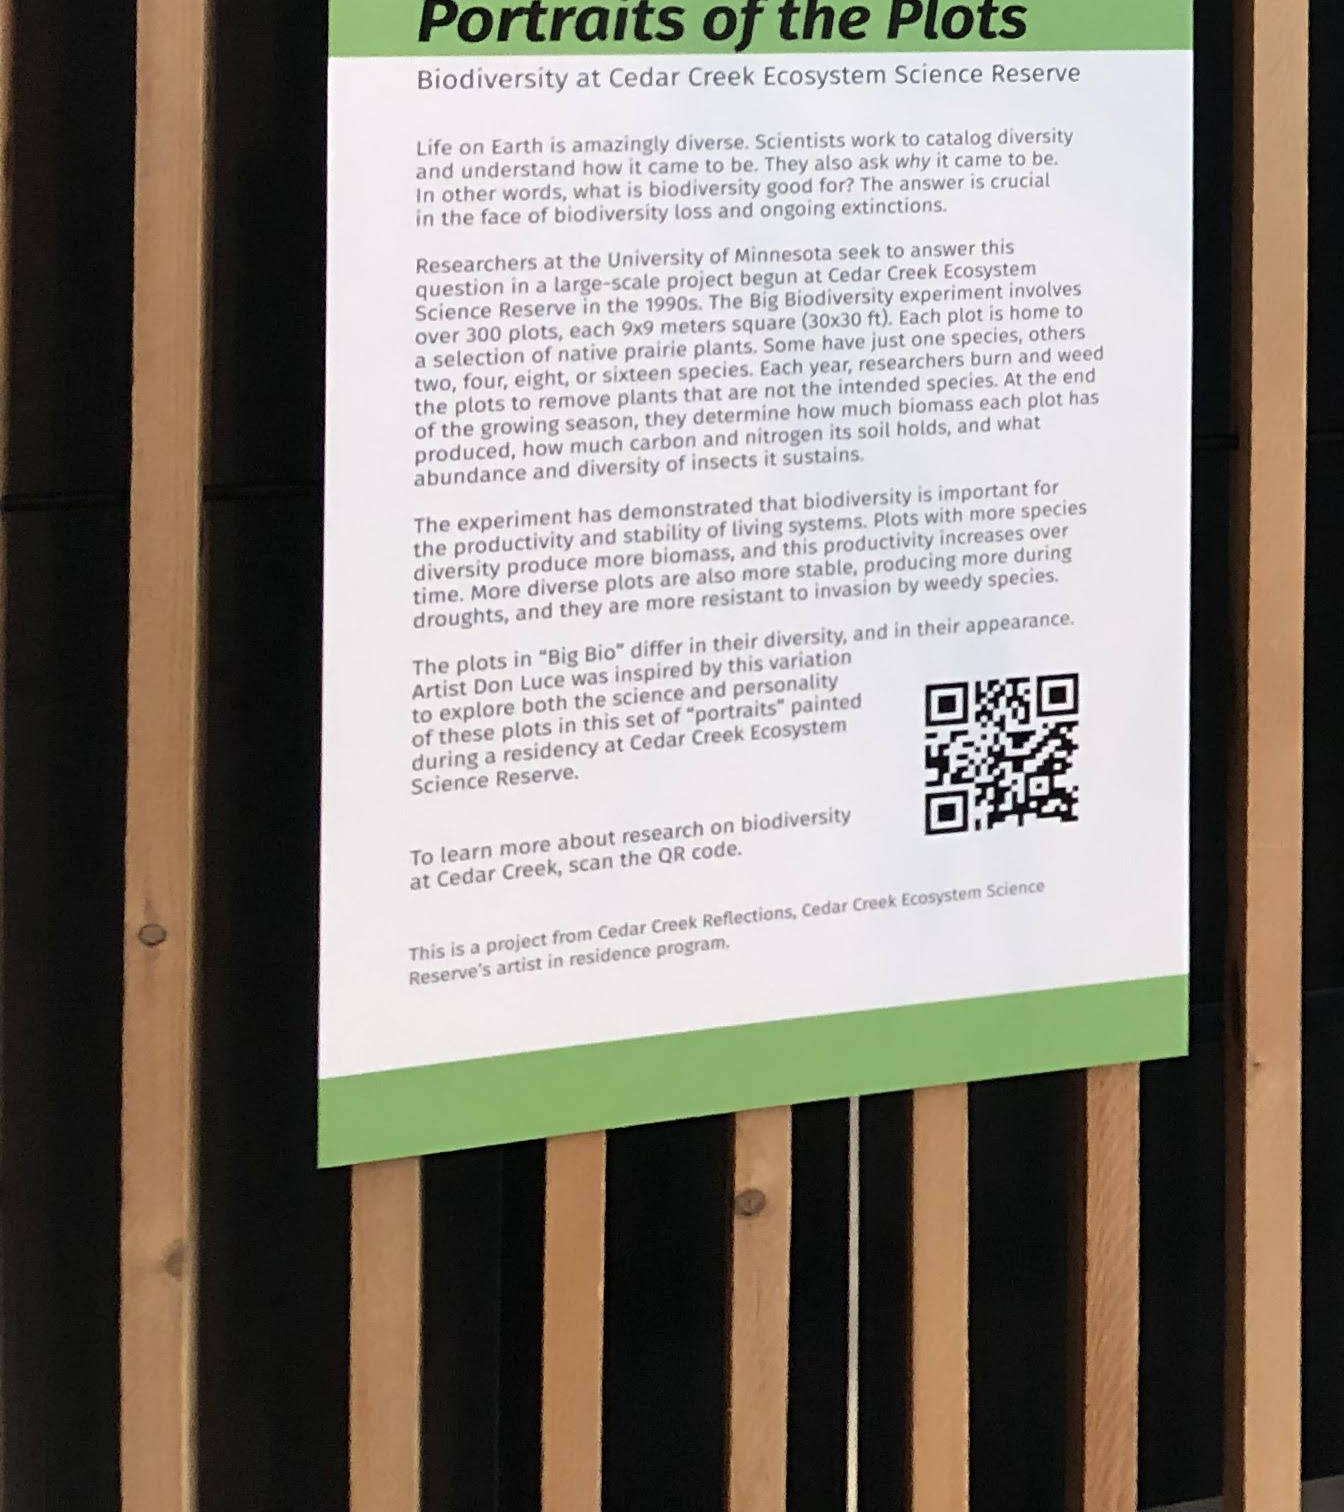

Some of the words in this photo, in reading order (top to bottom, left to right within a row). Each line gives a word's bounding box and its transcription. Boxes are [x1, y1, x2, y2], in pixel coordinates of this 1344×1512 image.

[418, 66, 569, 94] Biodiversity
[576, 69, 601, 89] at
[609, 66, 680, 89] Cedar
[688, 65, 755, 87] Creek
[764, 66, 886, 90] Ecosystem
[895, 63, 983, 85] Science
[992, 64, 1081, 83] Reserve
[417, 138, 453, 157] Life
[459, 142, 484, 156] on
[491, 137, 543, 155] Earth
[550, 136, 567, 154] is
[572, 135, 670, 156] amazingly
[675, 134, 749, 151] diverse.
[755, 131, 846, 150] Scientists
[851, 131, 896, 148] work
[901, 133, 920, 147] to
[925, 129, 992, 149] catalog
[997, 127, 1074, 147] diversity
[415, 162, 454, 180] and
[461, 159, 575, 179] understand
[582, 159, 623, 176] how
[629, 158, 642, 175] it
[648, 161, 699, 175] came
[705, 159, 724, 174] to
[731, 156, 758, 173] be.
[764, 155, 809, 175] They
[814, 154, 853, 171] also
[858, 153, 890, 170] ask
[895, 152, 932, 172] why
[937, 151, 949, 169] it
[954, 154, 1003, 169] came
[1008, 153, 1026, 167] to
[1032, 150, 1058, 166] be.
[416, 188, 435, 203] In
[442, 186, 497, 204] other
[502, 183, 567, 203] words,
[573, 183, 621, 200] what
[627, 181, 643, 199] is
[649, 178, 761, 199] biodiversity
[766, 177, 813, 199] good
[819, 176, 855, 194] for?
[860, 176, 894, 192] The
[899, 177, 965, 192] answer
[971, 173, 985, 190] is
[990, 171, 1050, 190] crucial
[415, 209, 434, 227] in
[441, 209, 474, 227] the
[481, 207, 521, 225] face
[528, 206, 549, 224] of
[554, 203, 669, 225] biodiversity
[675, 203, 712, 220] loss
[718, 201, 754, 219] and
[760, 199, 836, 221] ongoing
[841, 196, 947, 216] extinctions.
[416, 254, 538, 274] Researchers
[543, 255, 563, 270] at
[569, 252, 601, 269] the
[607, 248, 704, 269] University
[709, 247, 730, 265] of
[734, 246, 832, 264] Minnesota
[838, 242, 881, 261] seek
[886, 244, 905, 259] to
[910, 243, 976, 258] answer
[981, 237, 1015, 256] this
[415, 278, 504, 302] question
[511, 276, 529, 294] in
[535, 280, 547, 294] a
[667, 270, 734, 293] project
[740, 269, 798, 290] begun
[804, 269, 822, 284] at
[828, 266, 882, 283] Cedar
[887, 263, 938, 282] Creek
[944, 262, 1037, 281] Ecosystem
[415, 303, 492, 322] Science
[499, 301, 576, 318] Reserve
[583, 297, 601, 315] in
[607, 296, 639, 314] the
[645, 296, 702, 313] 1990s.
[708, 293, 743, 310] The
[750, 291, 779, 312] Big
[785, 286, 894, 308] Biodiversity
[899, 284, 1003, 306] experiment
[1009, 281, 1082, 298] involves
[413, 516, 451, 534] The
[457, 509, 571, 534] experiment
[578, 507, 613, 524] has
[618, 497, 753, 521] demonstrated
[759, 495, 797, 513] that
[803, 487, 912, 510] biodiversity
[918, 486, 933, 503] is
[938, 482, 1028, 504] important
[1034, 479, 1059, 496] for
[413, 559, 500, 582] diversity
[507, 555, 588, 579] produce
[595, 553, 645, 569] more
[651, 546, 735, 566] biomass,
[741, 540, 776, 560] and
[782, 537, 818, 557] this
[824, 531, 934, 558] productivity
[940, 528, 1025, 545] increases
[1029, 526, 1069, 540] over
[412, 658, 450, 677] The
[456, 654, 507, 677] plots
[514, 650, 532, 668] in
[630, 639, 683, 659] differ
[689, 636, 707, 654] in
[713, 632, 758, 653] their
[764, 627, 847, 649] diversity,
[853, 623, 888, 642] and
[894, 621, 911, 638] in
[917, 617, 960, 637] their
[965, 613, 1074, 636] appearance.
[411, 774, 489, 796] Science
[496, 767, 579, 787] Reserve.
[408, 943, 445, 962] This
[451, 941, 465, 957] is
[470, 942, 481, 955] a
[486, 933, 547, 956] project
[552, 929, 592, 945] from
[597, 922, 647, 940] Cedar
[651, 915, 698, 934] Creek
[702, 906, 797, 928] Reflections,
[801, 900, 848, 917] Cedar
[853, 894, 897, 912] Creek
[902, 888, 982, 907] Ecosystem
[987, 881, 1045, 898] Science
[496, 956, 542, 976] artist
[548, 953, 564, 969] in
[569, 946, 652, 966] residence
[656, 937, 730, 960] program.
